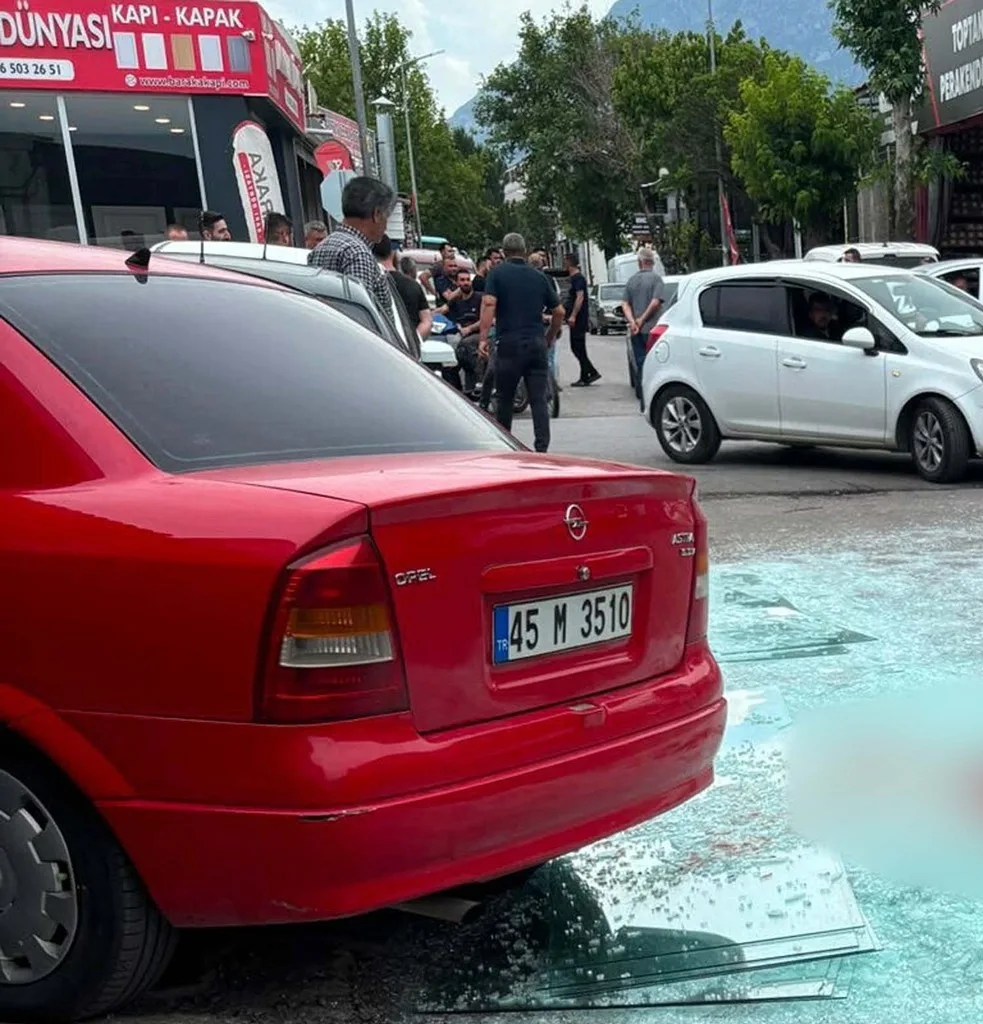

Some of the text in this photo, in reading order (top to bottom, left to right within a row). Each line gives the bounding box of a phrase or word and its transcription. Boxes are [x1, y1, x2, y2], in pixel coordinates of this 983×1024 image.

[0, 0, 113, 49] DÜNYASI
[110, 3, 159, 25] KAPI
[175, 6, 244, 28] KAPAK
[9, 63, 30, 75] 503
[32, 63, 47, 75] 26
[48, 64, 61, 75] 51
[138, 76, 250, 91] www.barakakapi.com
[395, 567, 437, 586] OPEL
[497, 591, 630, 652] TR 45 M 3510
